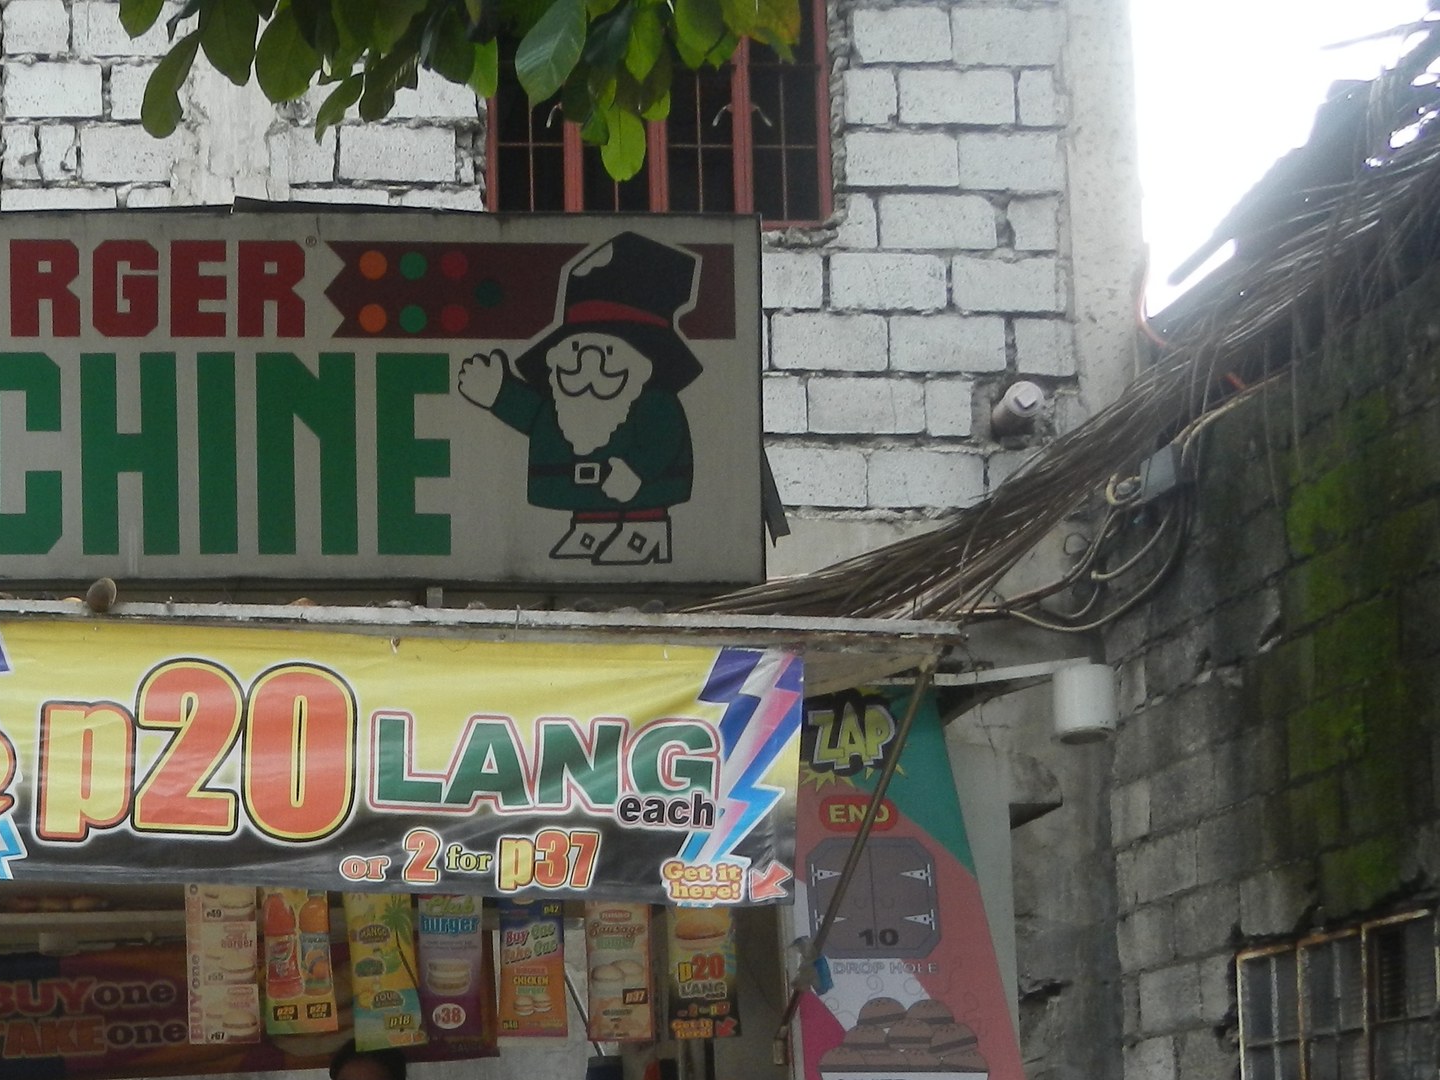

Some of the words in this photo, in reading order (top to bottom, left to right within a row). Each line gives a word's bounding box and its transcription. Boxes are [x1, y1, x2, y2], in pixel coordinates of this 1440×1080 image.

[808, 702, 896, 769] ZAP
[36, 657, 357, 842] p20
[370, 711, 720, 812] LANG
[617, 793, 716, 828] each
[829, 804, 890, 824] END
[340, 856, 389, 881] or
[403, 828, 441, 884] 2
[446, 844, 494, 872] for
[497, 829, 601, 891] p37
[663, 861, 712, 881] Get
[716, 863, 742, 881] it
[670, 880, 740, 900] here!
[858, 928, 899, 946] 10
[833, 961, 885, 975] DROP
[93, 981, 176, 1007] one
[106, 1020, 187, 1045] one
